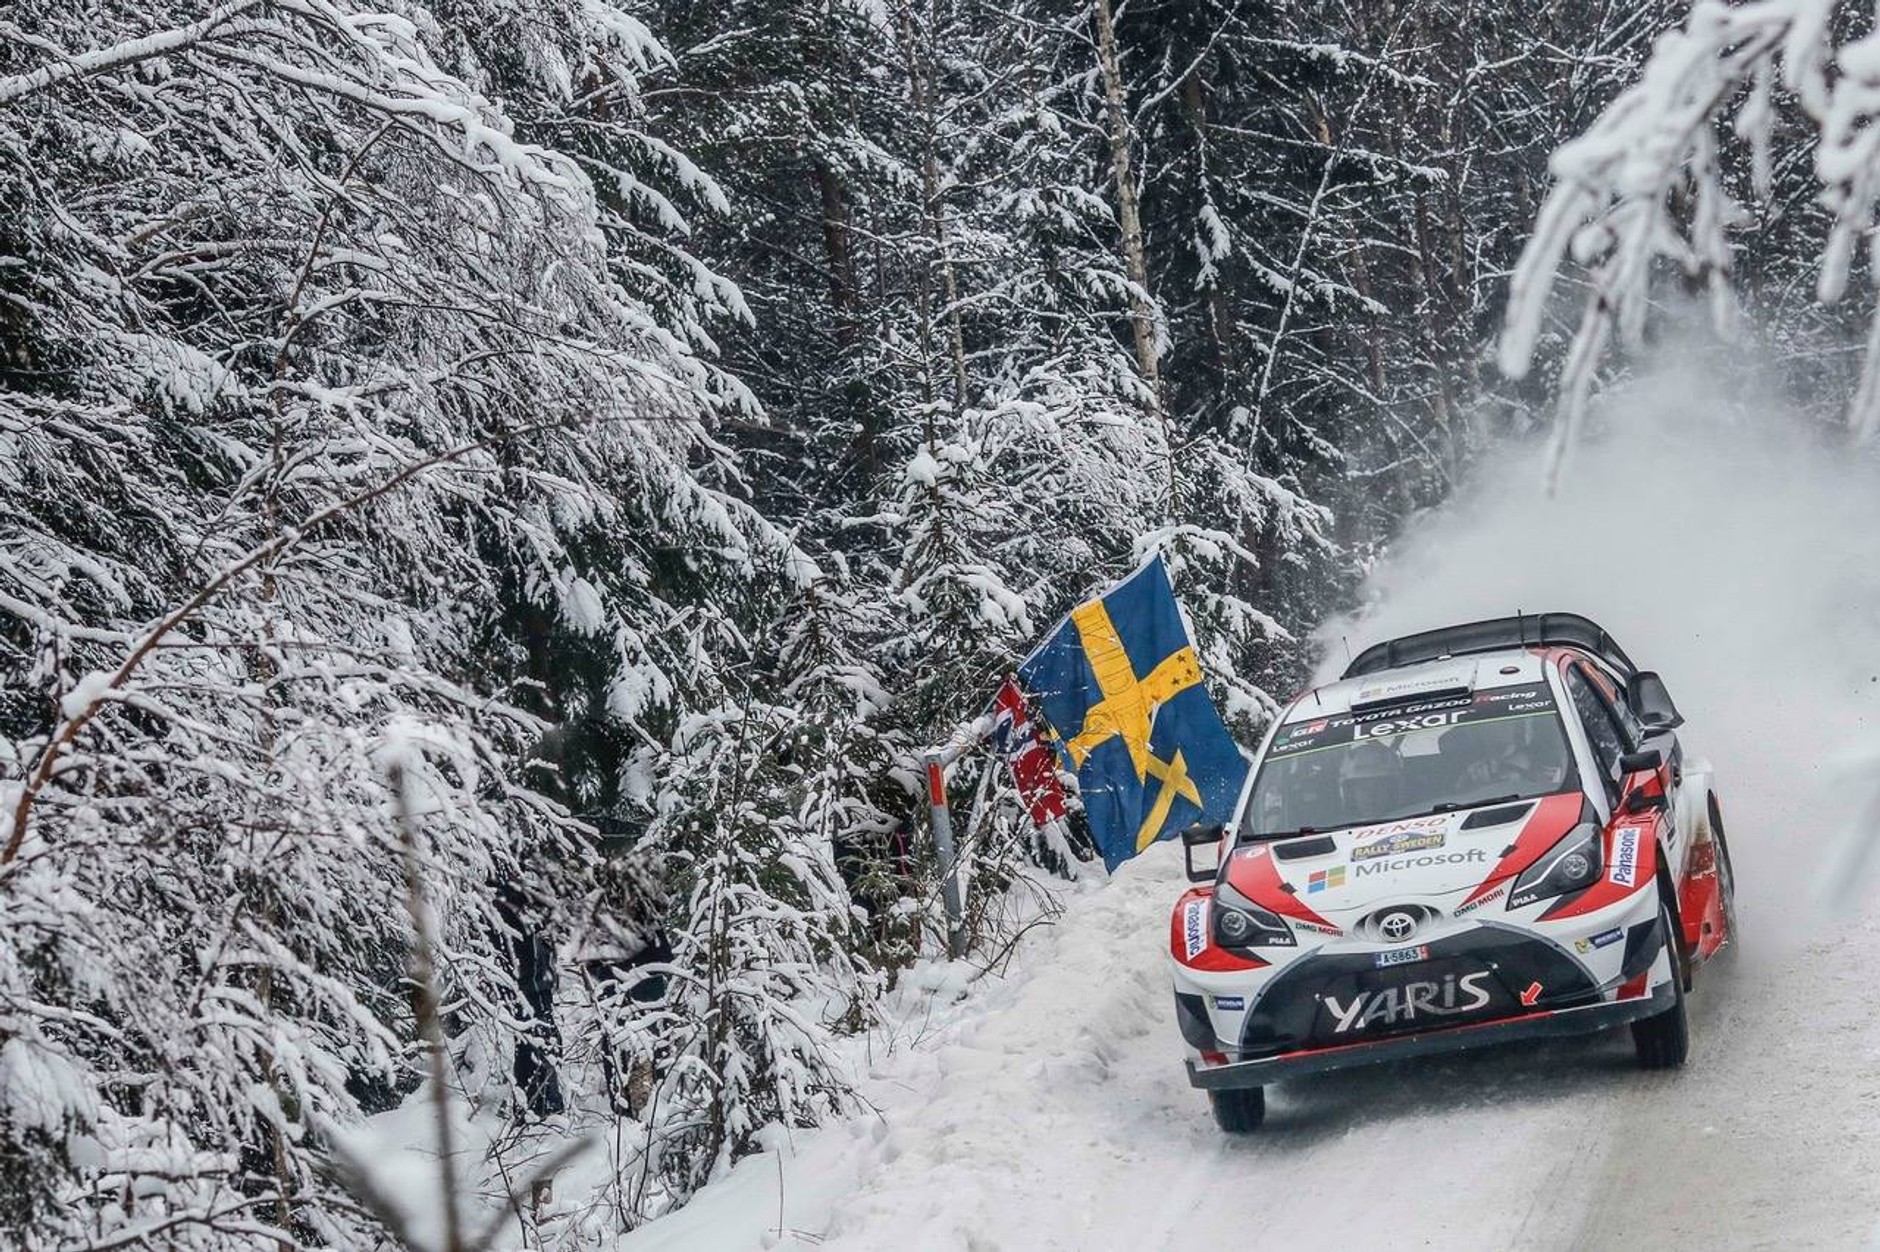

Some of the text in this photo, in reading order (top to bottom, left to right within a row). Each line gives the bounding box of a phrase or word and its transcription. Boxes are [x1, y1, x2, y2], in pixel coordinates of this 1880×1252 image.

[1330, 708, 1401, 728] TOYOTA
[1406, 697, 1472, 713] GAZOO
[1473, 690, 1537, 704] Racing
[1507, 699, 1552, 712] Lexar
[1354, 708, 1470, 740] Lexar
[1273, 738, 1316, 753] Lexar
[1356, 817, 1446, 839] DENSO
[1354, 844, 1391, 858] RALLY
[1392, 834, 1443, 853] SWEDEN
[1355, 848, 1487, 878] Microsoft
[1453, 888, 1505, 918] DMG MORI
[1512, 893, 1539, 908] PIAA
[1268, 936, 1292, 945] PIAA
[1295, 922, 1344, 937] DMG MORI
